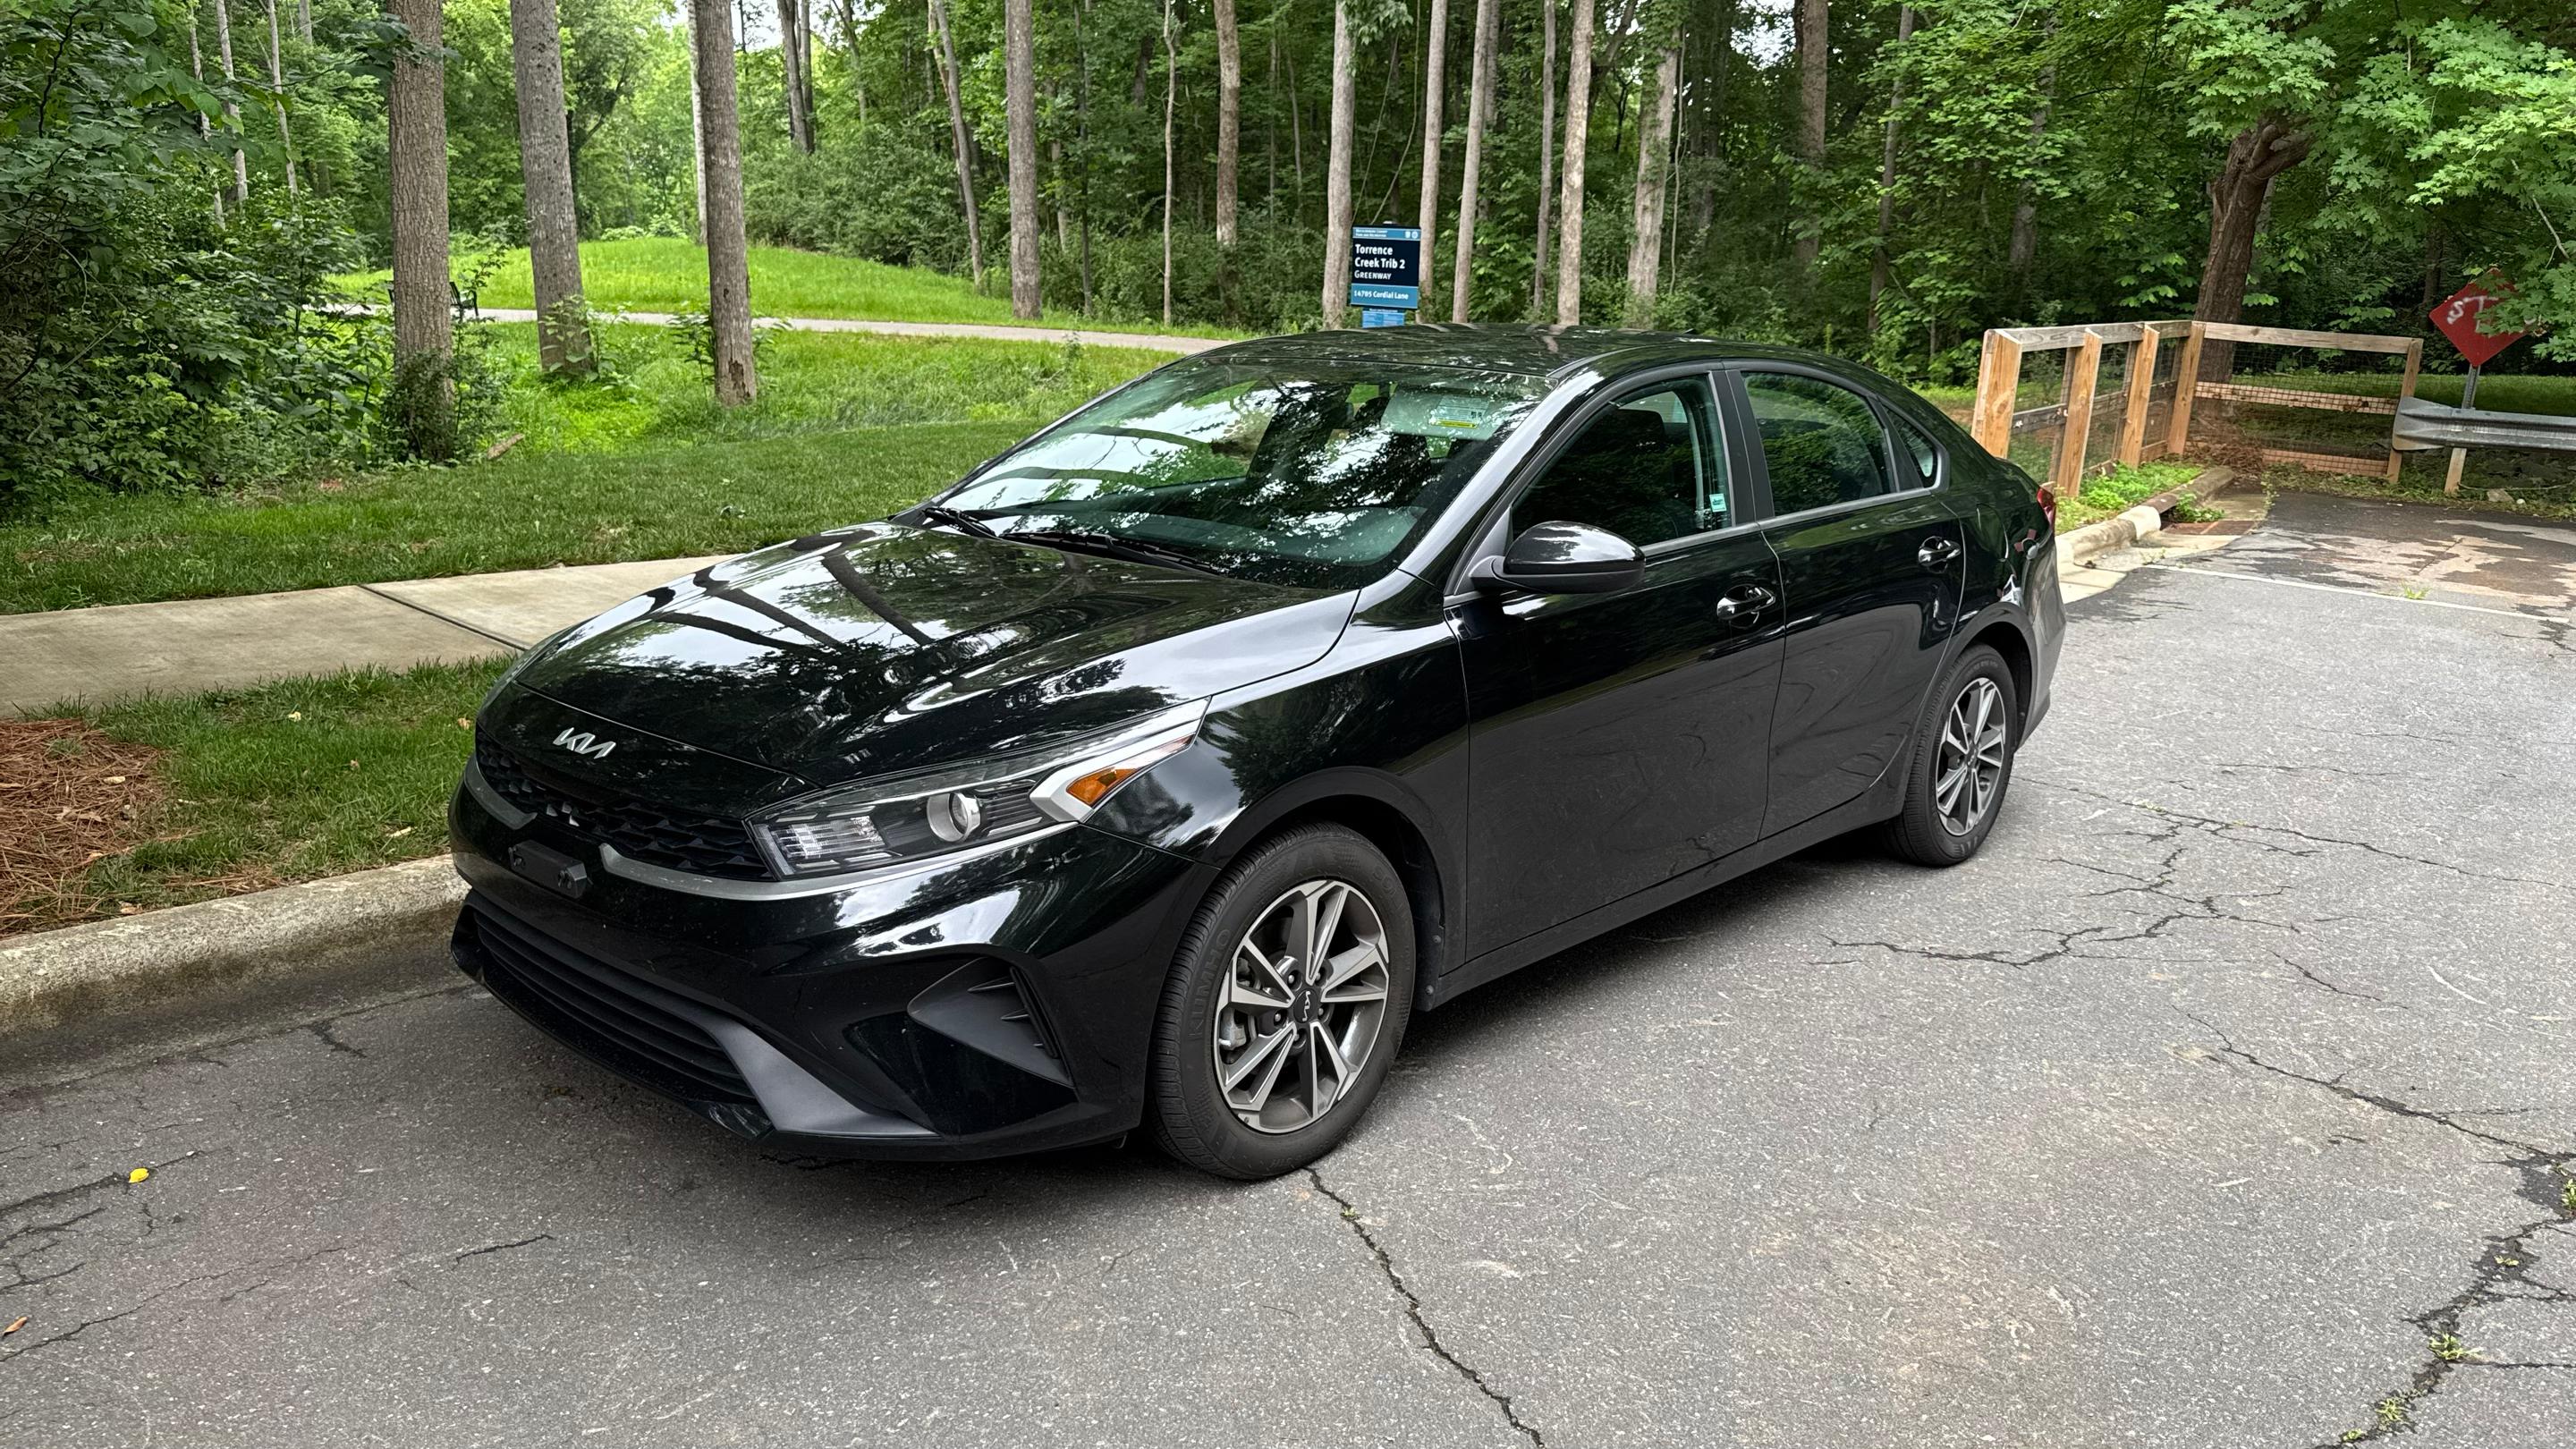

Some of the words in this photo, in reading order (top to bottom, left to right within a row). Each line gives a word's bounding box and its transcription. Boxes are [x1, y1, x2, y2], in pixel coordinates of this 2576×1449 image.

[1354, 243, 1394, 256] Torrence
[1354, 258, 1379, 268] Creek
[1380, 258, 1398, 268] Trib
[1399, 259, 1405, 269] 2
[1354, 270, 1392, 280] GREENWAY
[1373, 291, 1394, 299] Cordial
[1394, 292, 1410, 300] Lane
[2447, 295, 2541, 333] ST
